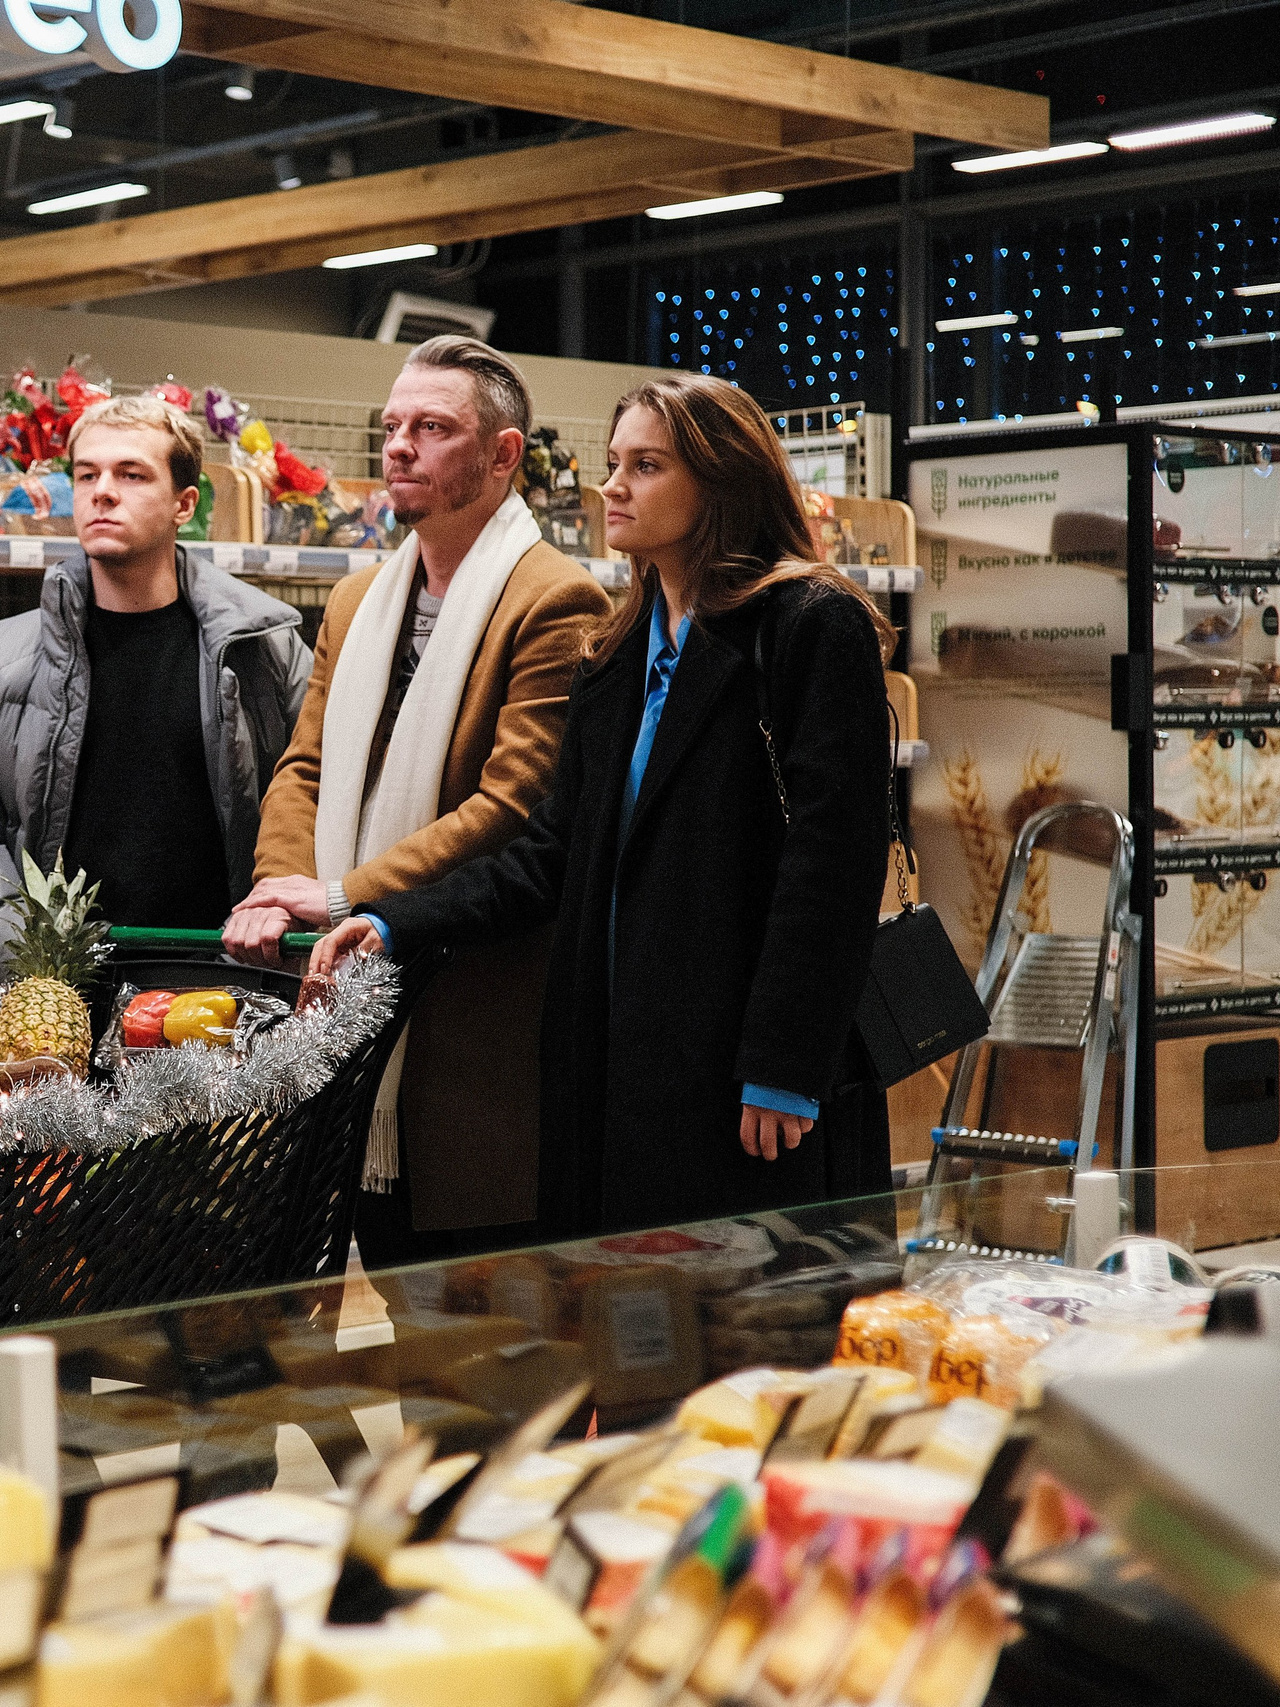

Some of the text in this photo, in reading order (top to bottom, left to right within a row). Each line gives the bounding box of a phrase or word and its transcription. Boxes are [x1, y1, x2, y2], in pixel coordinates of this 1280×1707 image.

[957, 469, 1060, 490] Натуральные
[957, 491, 1057, 510] ингредиенты
[958, 554, 1010, 571] Вкусно
[1014, 553, 1040, 566] как
[1032, 622, 1106, 643] корочкой
